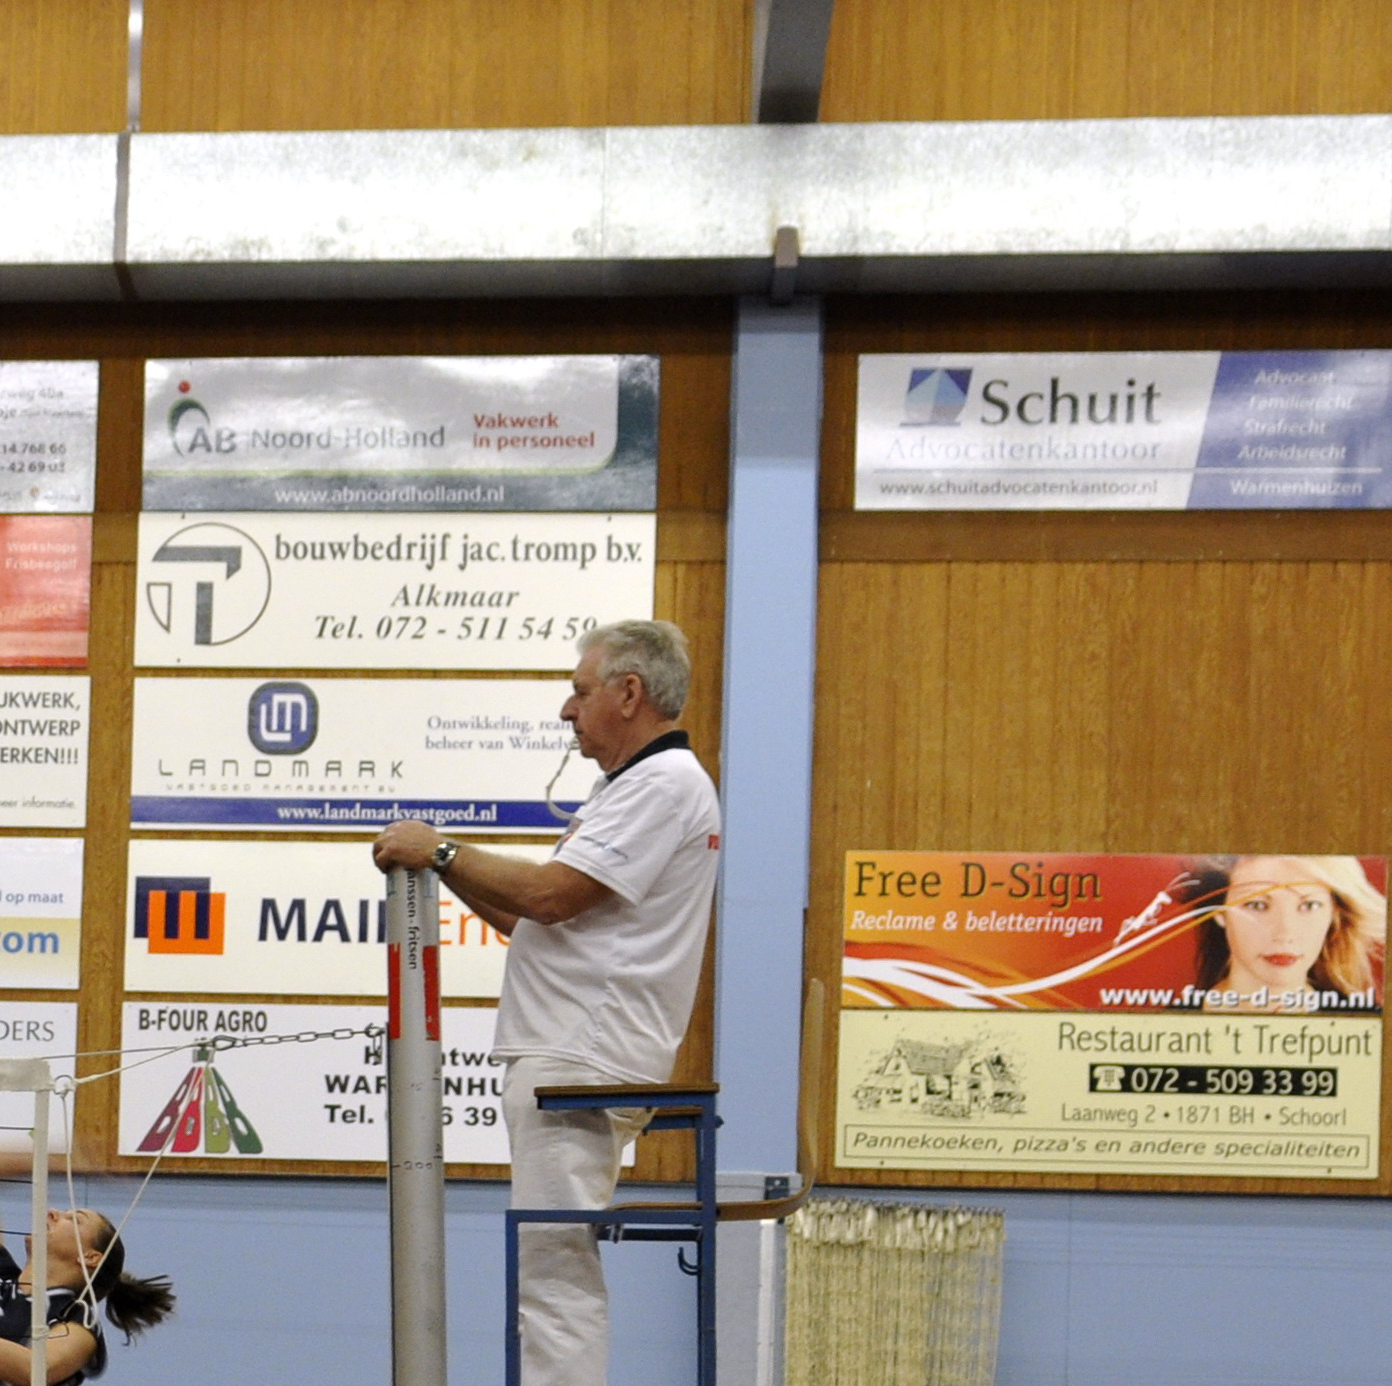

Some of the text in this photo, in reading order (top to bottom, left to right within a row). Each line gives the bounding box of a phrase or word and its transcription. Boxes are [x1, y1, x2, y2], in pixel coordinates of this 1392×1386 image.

[980, 376, 1161, 425] Schuit
[474, 413, 559, 429] Vakwerk
[189, 425, 445, 454] AB Noord-Holland
[474, 432, 595, 451] in personeel
[886, 437, 1160, 462] Advocatenkantoor
[275, 486, 505, 504] www.abnoordholland.nl
[879, 479, 1158, 496] www.schuitadvocatenkantoor.nl
[275, 533, 597, 571] bouwbedrijf jac. tromp
[392, 583, 520, 608] Alkmaar
[315, 615, 556, 641] Tel. 072 511 54
[427, 714, 535, 733] Ontwikkeling,
[425, 736, 503, 750] beheer van
[158, 759, 404, 779] LANDMARK
[277, 803, 497, 824] www.landmarkvastgoed.nl
[854, 862, 1102, 910] Free D-Sign
[5, 892, 63, 906] op maat
[852, 910, 1103, 935] Reclame & beletteringen
[1100, 984, 1377, 1011] www.free-d-sign.nl
[139, 1008, 267, 1033] B-FOUR AGRO
[1058, 1023, 1373, 1062] Restaurant Trefpunt
[1131, 1068, 1334, 1095] 072 509 33 99
[324, 1104, 374, 1124] Tel.
[1060, 1104, 1347, 1127] Laanweg 2 1871 BH Schoorl
[852, 1132, 1361, 1159] Pannekoeken, pizza's en andere specialiteiten
